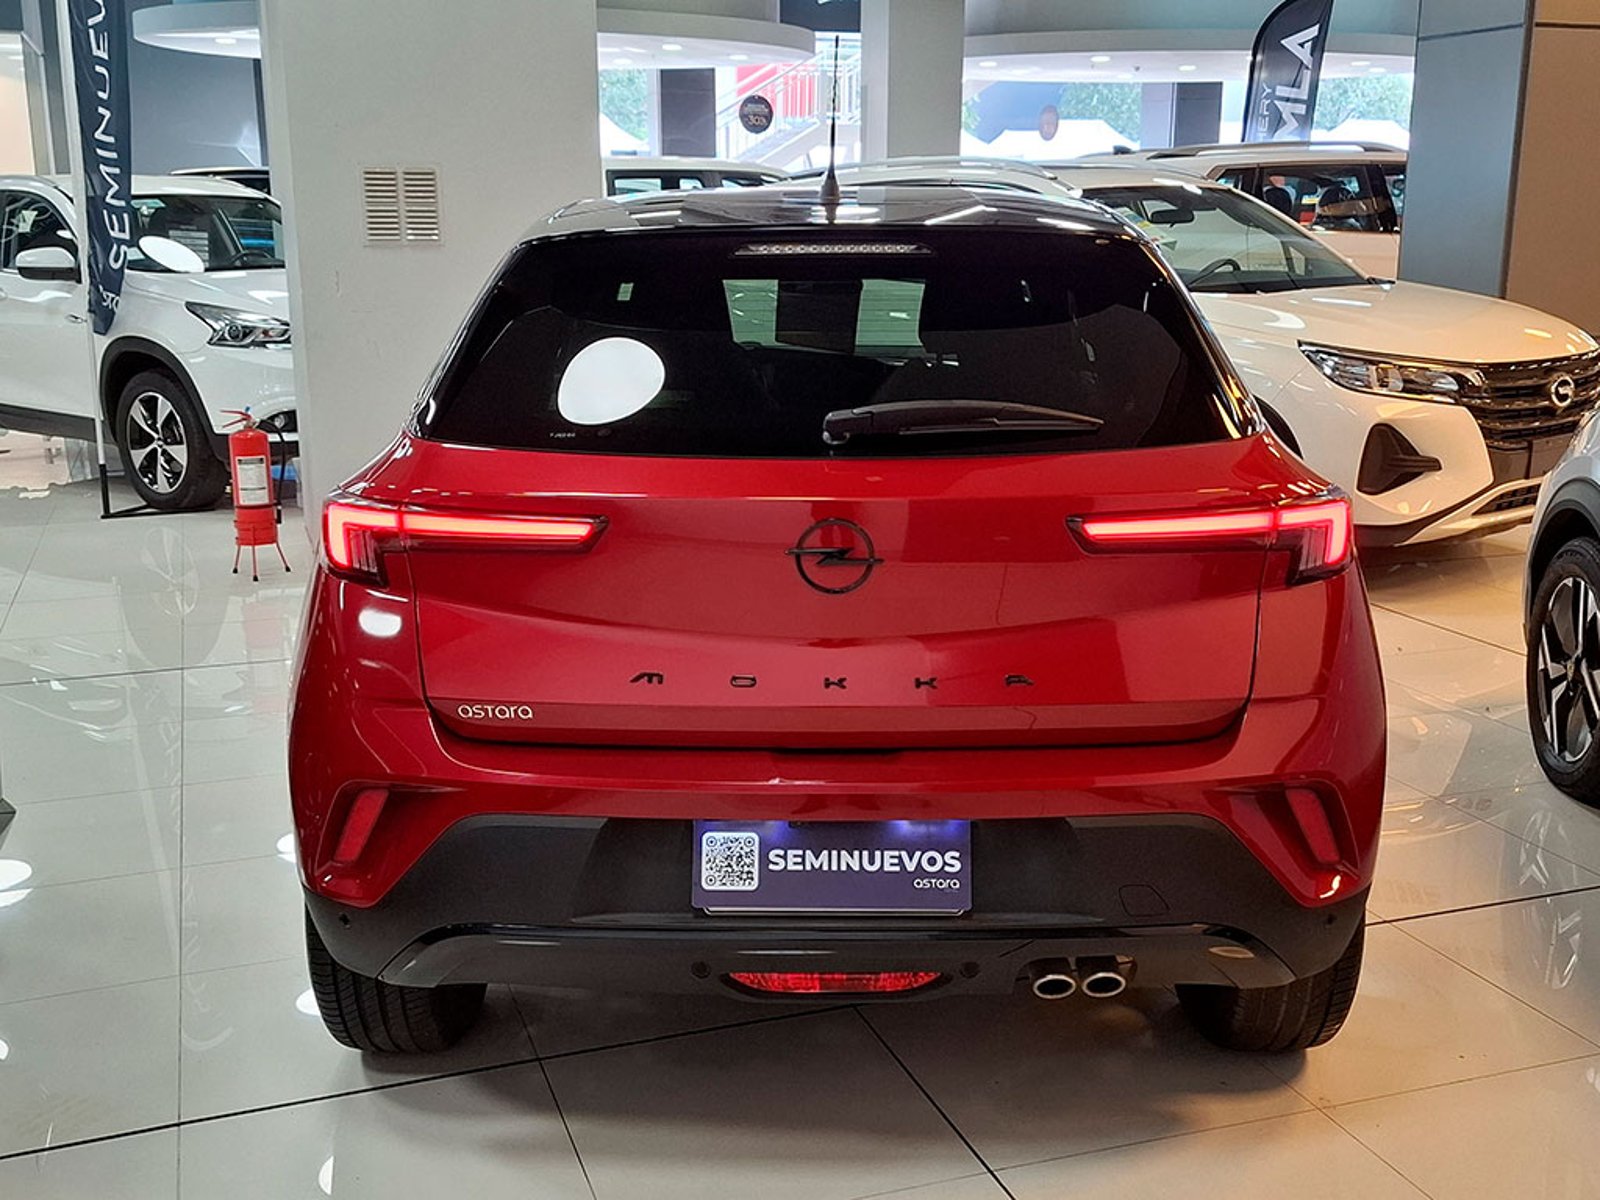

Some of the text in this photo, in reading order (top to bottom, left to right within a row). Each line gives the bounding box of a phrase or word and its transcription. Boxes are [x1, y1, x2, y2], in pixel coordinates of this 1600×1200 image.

[630, 671, 1035, 690] MOKKA
[457, 704, 534, 719] astara
[768, 849, 962, 873] SEMINUEVOS
